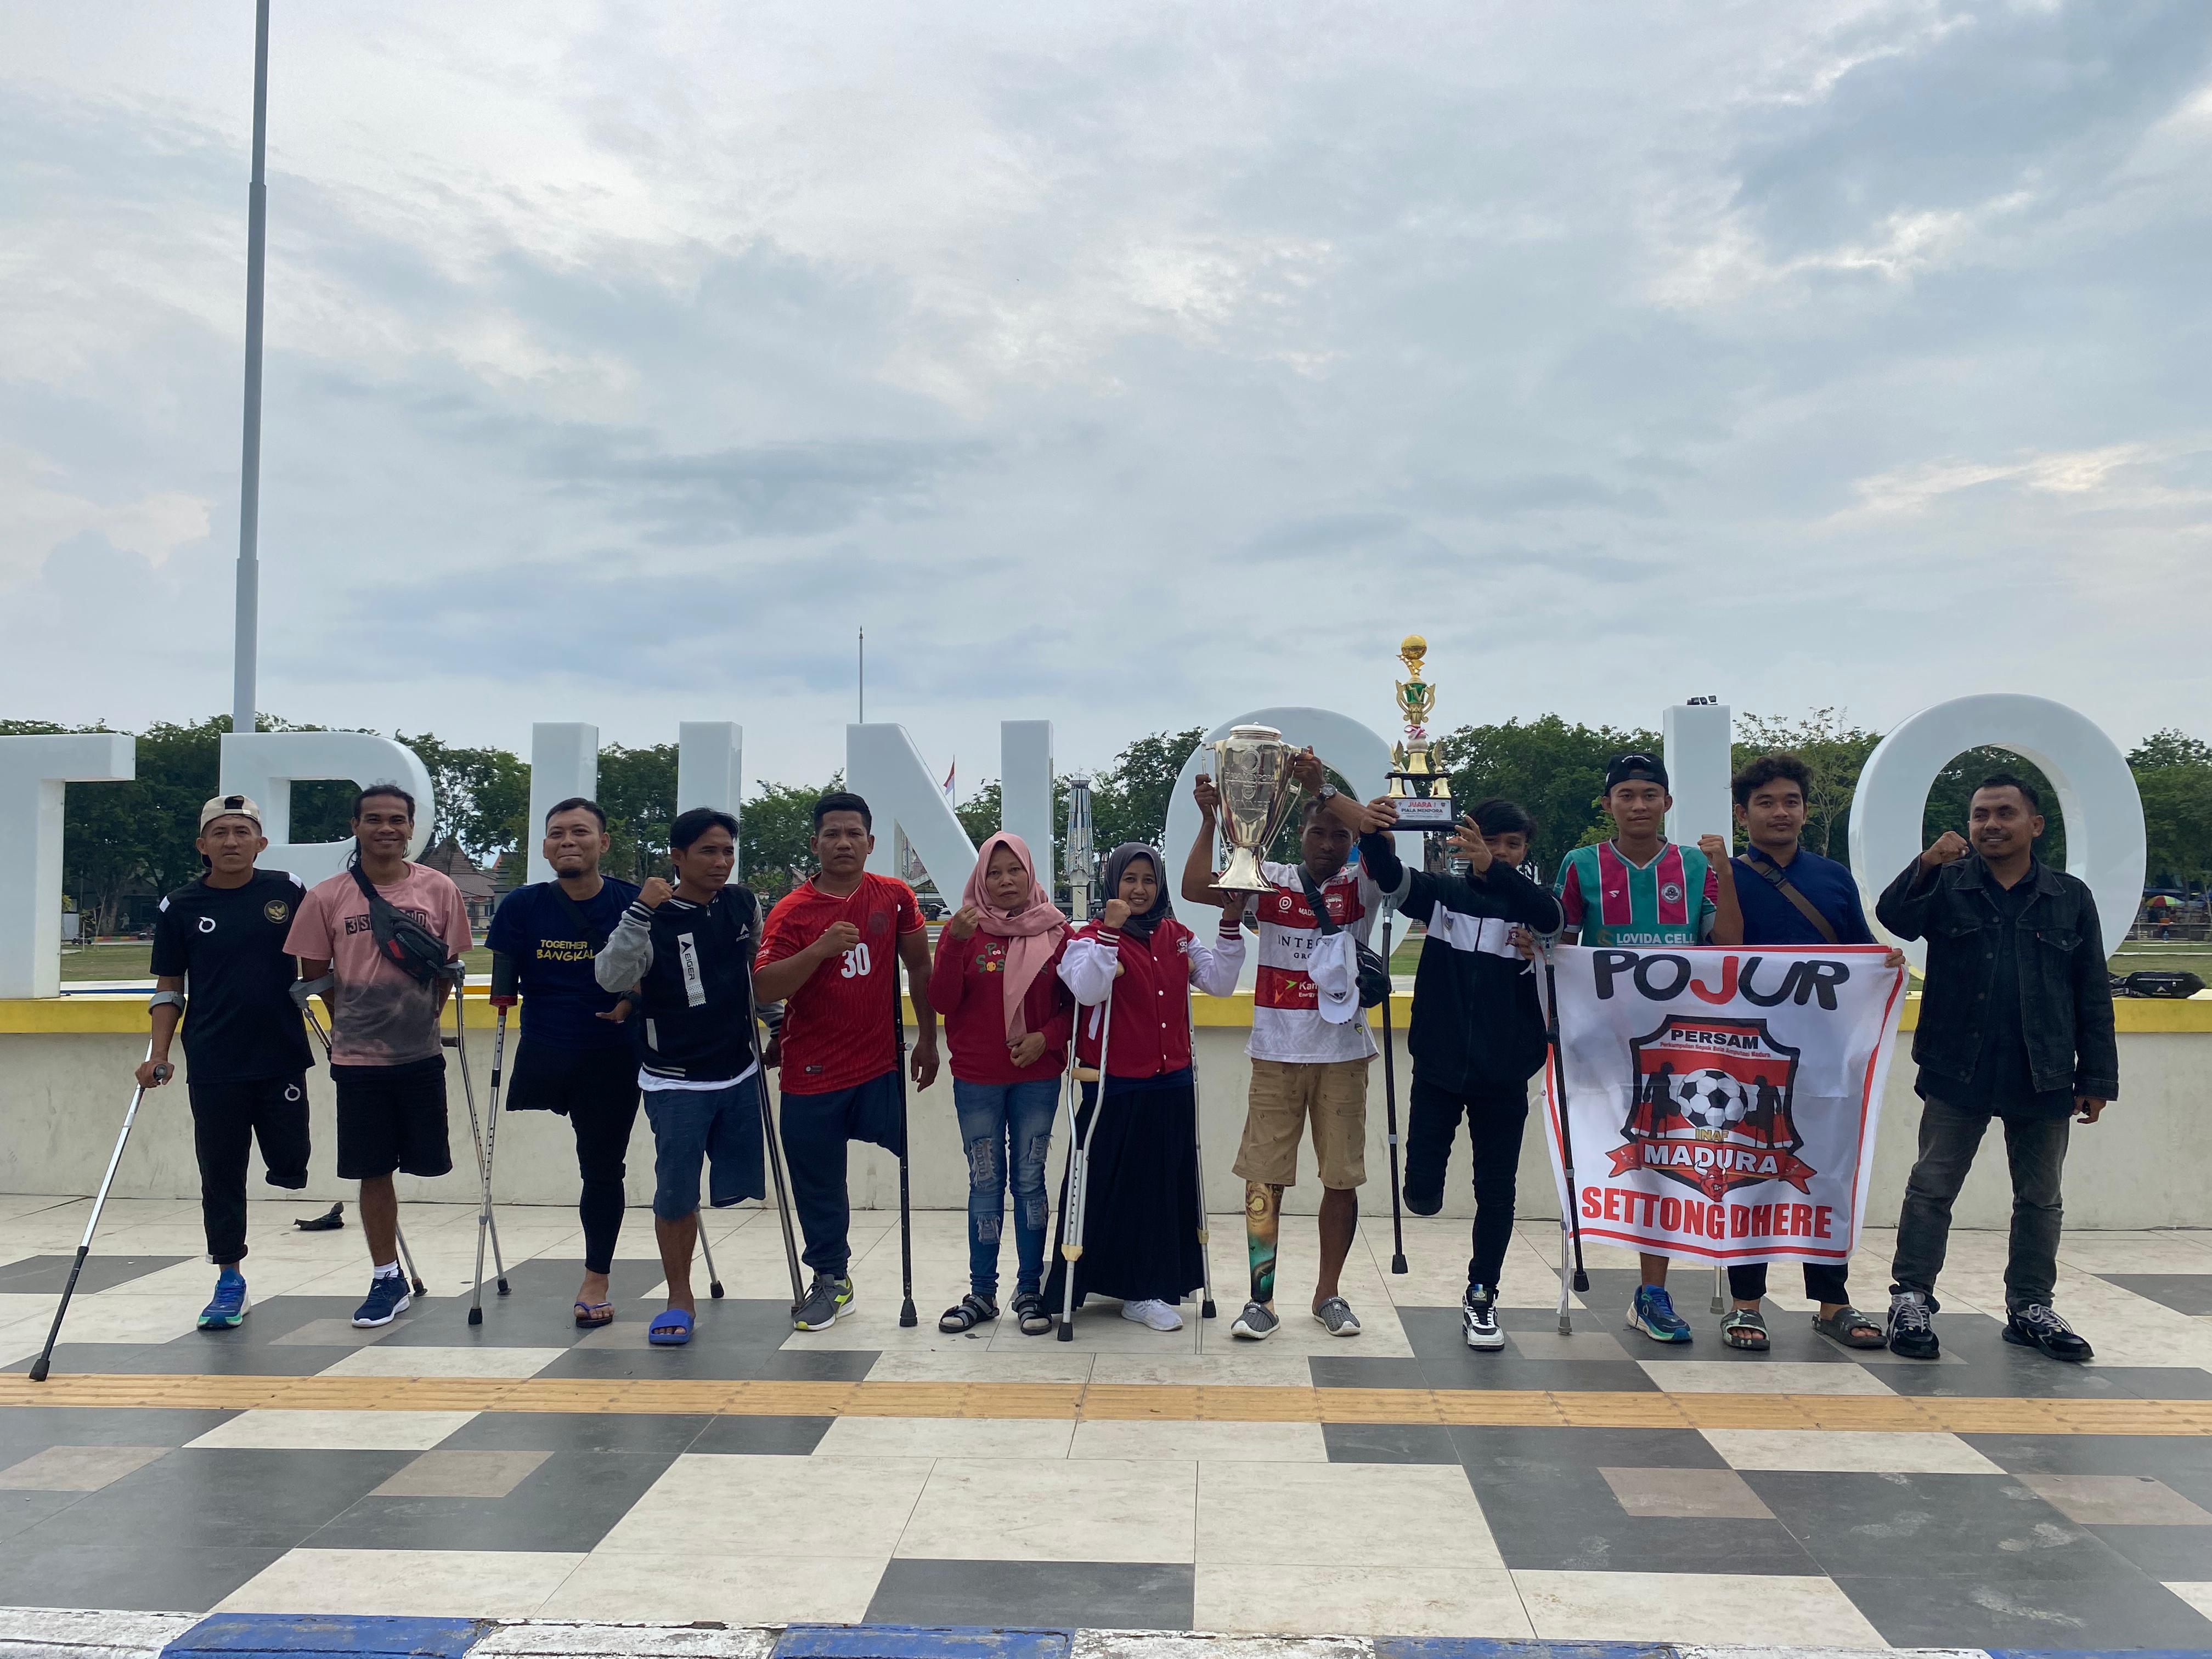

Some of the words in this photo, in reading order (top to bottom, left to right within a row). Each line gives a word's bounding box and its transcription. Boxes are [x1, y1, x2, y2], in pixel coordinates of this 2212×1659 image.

[540, 939, 588, 950] TOGETHER
[1617, 933, 1662, 944] LOVIDA
[1664, 933, 1695, 944] CELL
[685, 953, 695, 981] EIGER
[840, 943, 871, 979] 30
[1593, 950, 1850, 1011] POJUR
[1671, 1029, 1758, 1049] PERSAM
[1644, 1145, 1779, 1174] MADURA
[1582, 1186, 1725, 1240] SETTONG
[1730, 1204, 1832, 1239] DHERE
